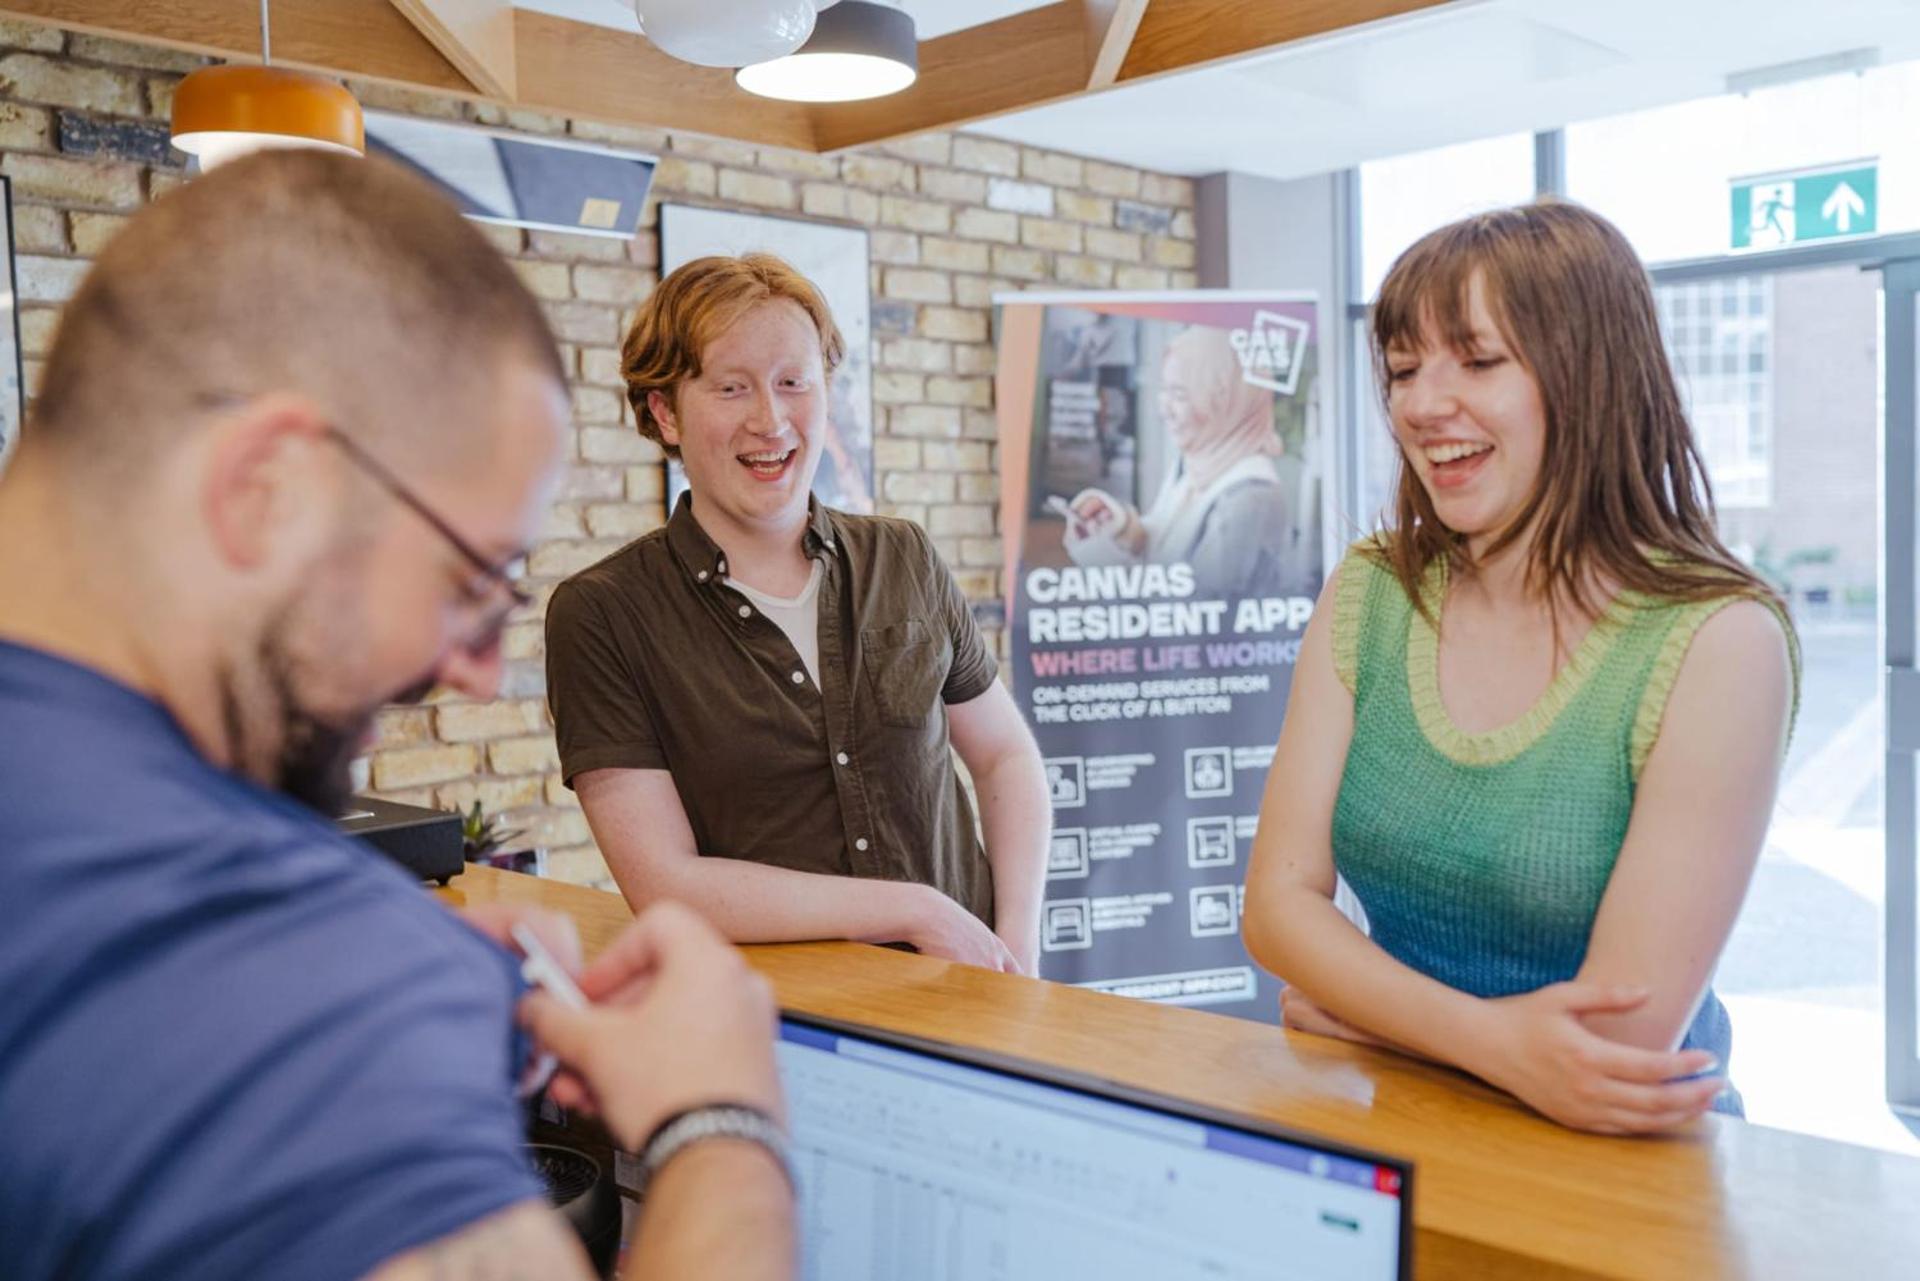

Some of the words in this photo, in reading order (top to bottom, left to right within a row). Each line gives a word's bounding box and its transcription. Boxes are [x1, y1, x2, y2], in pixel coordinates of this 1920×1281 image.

[1230, 328, 1288, 350] CAN
[1237, 347, 1290, 368] VAS
[1026, 562, 1195, 602] CANVAS
[1028, 600, 1228, 643] RESIDENT
[1233, 596, 1314, 633] APP
[1031, 648, 1137, 677] WHERE
[1143, 643, 1200, 671] LIFE
[1206, 638, 1301, 667] WORK
[1032, 682, 1138, 705] ON-DEMAND
[1140, 677, 1218, 699] SERVICES
[1219, 674, 1270, 694] FROM
[1033, 704, 1068, 723] THE
[1069, 700, 1121, 721] CLICK
[1122, 699, 1148, 718] OF
[1148, 698, 1163, 717] A
[1164, 695, 1231, 716] BUTTON
